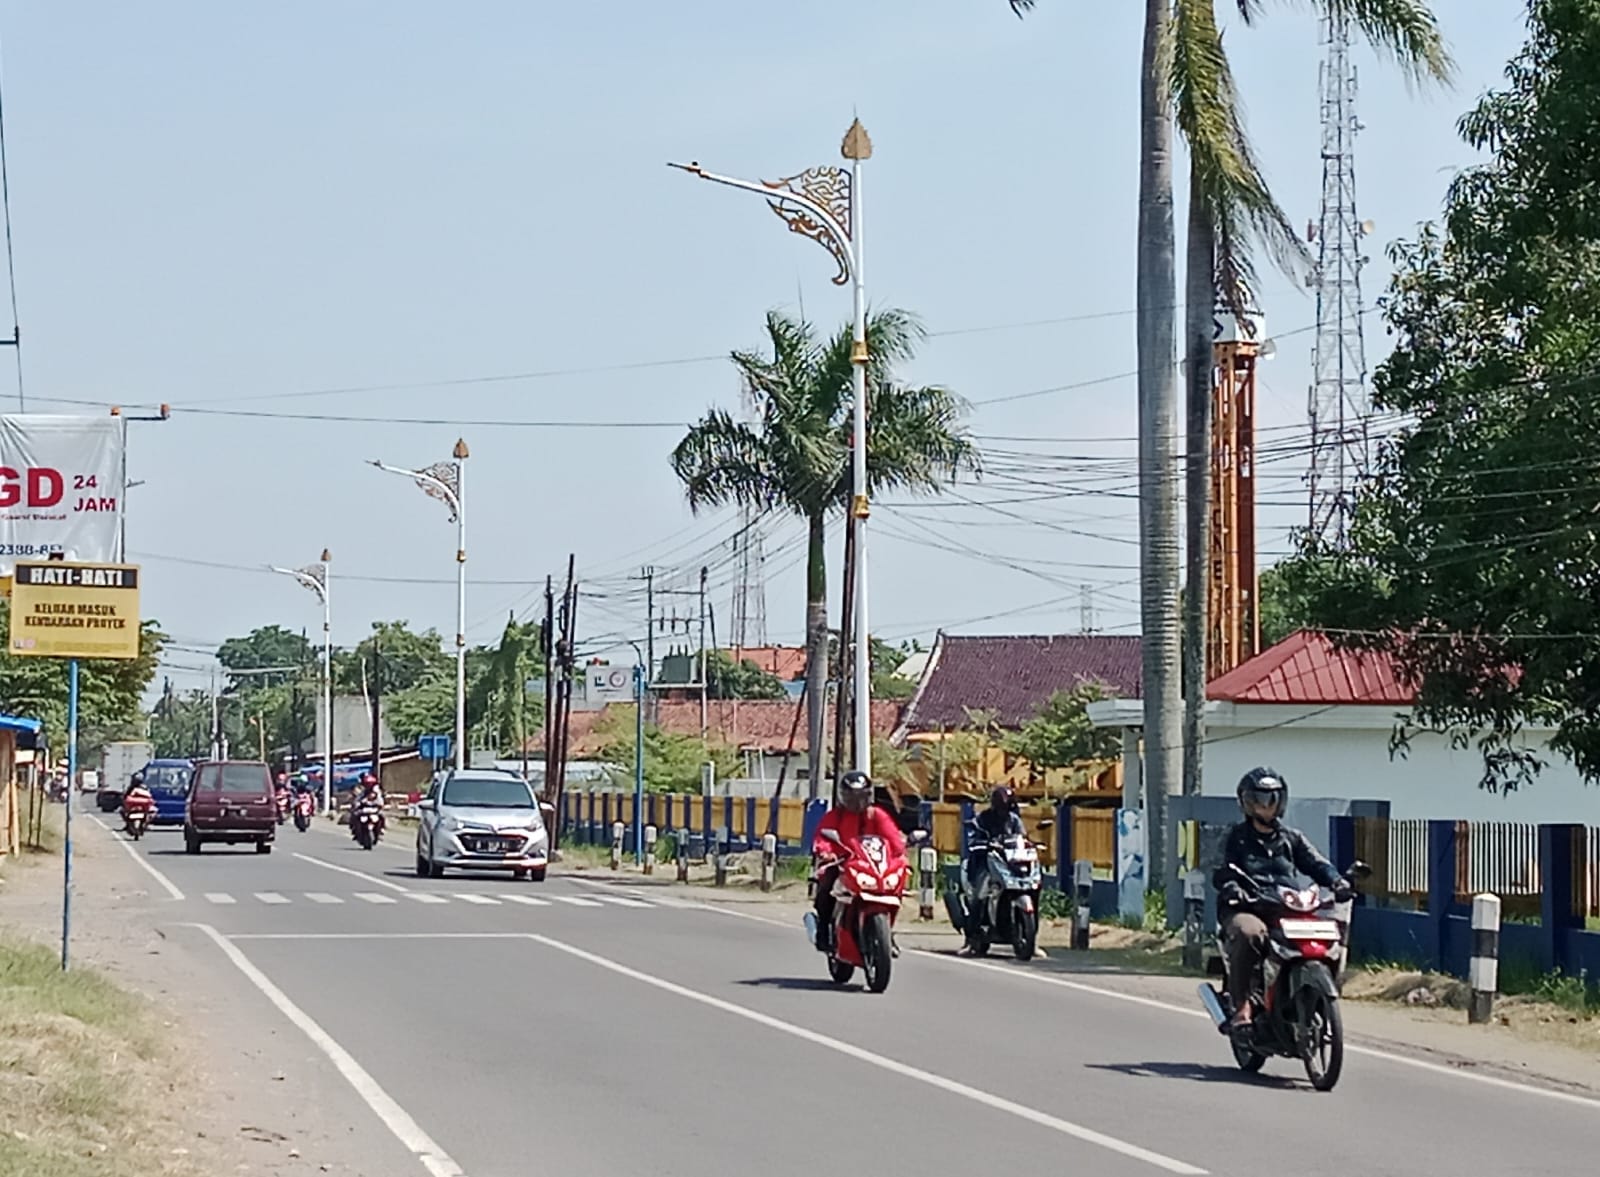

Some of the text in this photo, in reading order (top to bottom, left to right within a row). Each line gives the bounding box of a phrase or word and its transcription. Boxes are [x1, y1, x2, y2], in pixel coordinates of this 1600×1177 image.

[74, 475, 97, 489] 24
[74, 498, 116, 512] JAM
[30, 567, 122, 586] HATI-HATI
[34, 603, 116, 616] KELUAR MASUK
[86, 617, 126, 629] PROYEK
